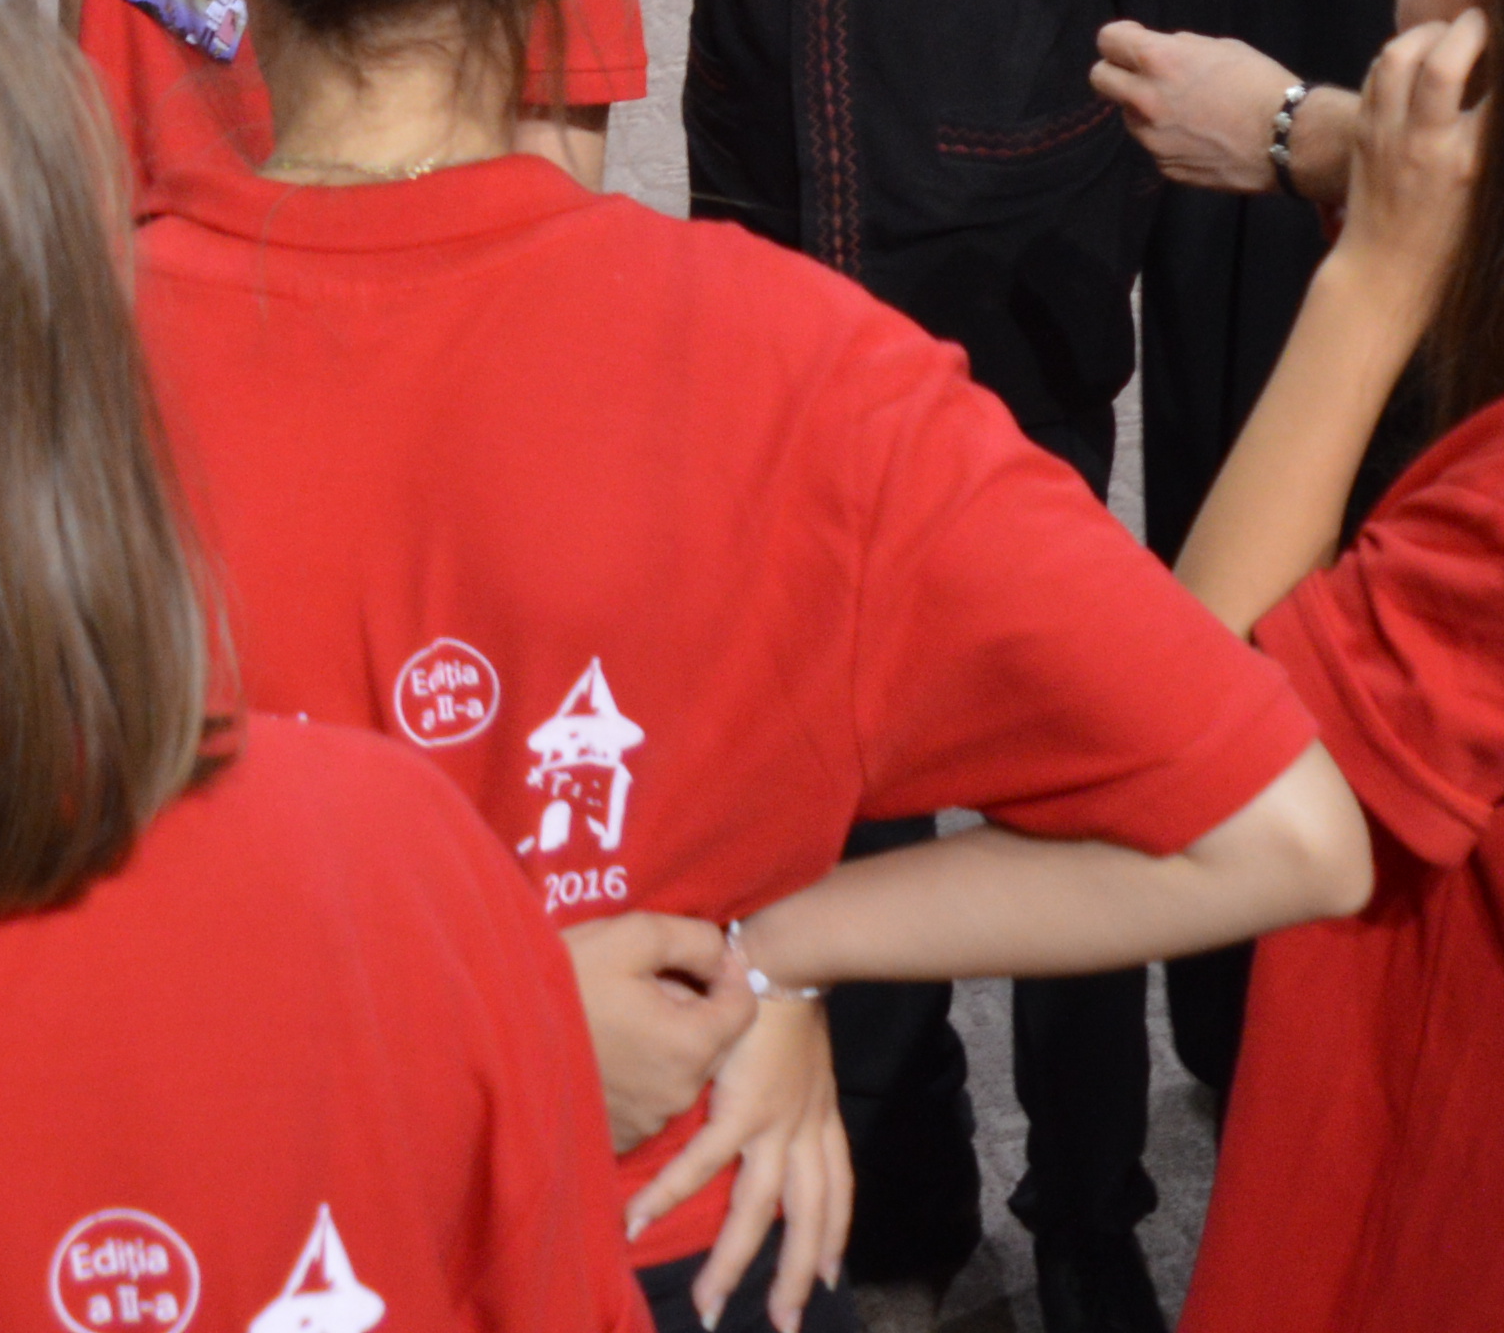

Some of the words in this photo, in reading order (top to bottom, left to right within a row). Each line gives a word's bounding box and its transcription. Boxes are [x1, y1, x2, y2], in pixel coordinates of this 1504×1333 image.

[543, 864, 629, 914] 2016
[69, 1238, 170, 1282] Ediția
[88, 1295, 112, 1325] a
